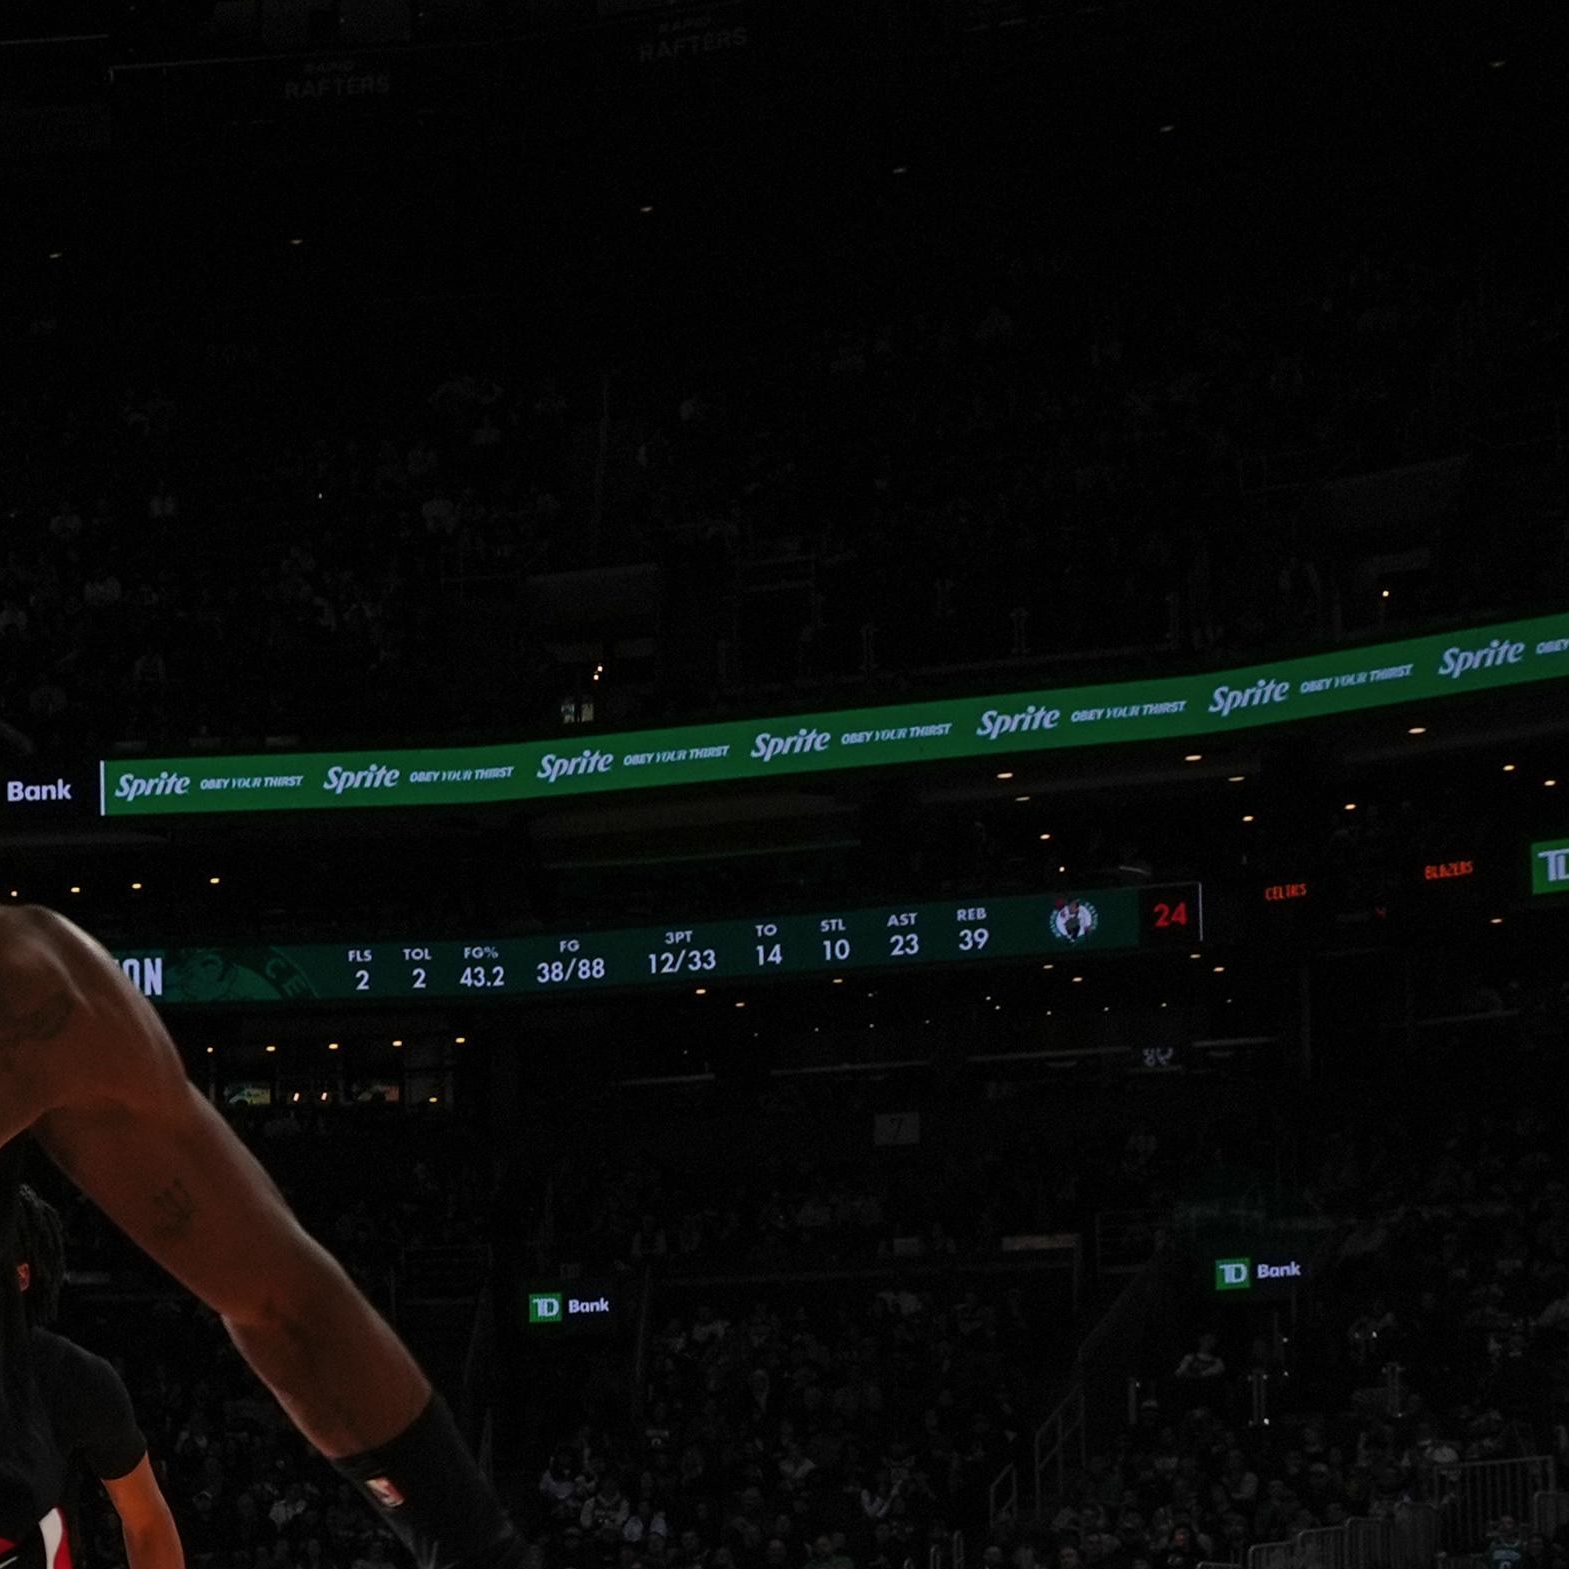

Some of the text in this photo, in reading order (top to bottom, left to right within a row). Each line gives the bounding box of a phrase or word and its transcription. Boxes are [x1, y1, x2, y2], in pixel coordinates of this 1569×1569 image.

[1439, 639, 1525, 678] Sprite
[1208, 679, 1290, 716] Sprite
[976, 705, 1060, 740] Sprite
[750, 728, 831, 762] Sprite
[536, 750, 614, 783] Sprite
[6, 778, 73, 803] Bank
[115, 771, 191, 802] Sprite
[323, 764, 400, 794] Sprite
[819, 918, 847, 933] STL
[886, 912, 918, 928] AST
[955, 907, 987, 922] REB
[1151, 901, 1190, 929] 24
[664, 929, 694, 945] 3PT
[754, 923, 778, 938] TO
[958, 928, 991, 952] 39
[347, 949, 373, 963] FLS
[402, 948, 432, 962] TOL
[463, 945, 499, 960] FG%
[559, 939, 581, 953] FG
[755, 943, 783, 967] 14
[821, 938, 852, 962] 10
[889, 933, 920, 957] 23
[535, 957, 606, 985] 38/88
[647, 948, 717, 975] 12/33
[354, 969, 371, 991] 2
[411, 968, 427, 990] 2
[459, 965, 505, 988] 43.2
[1219, 1260, 1302, 1285] TD Bank
[532, 1296, 610, 1318] TD Bank
